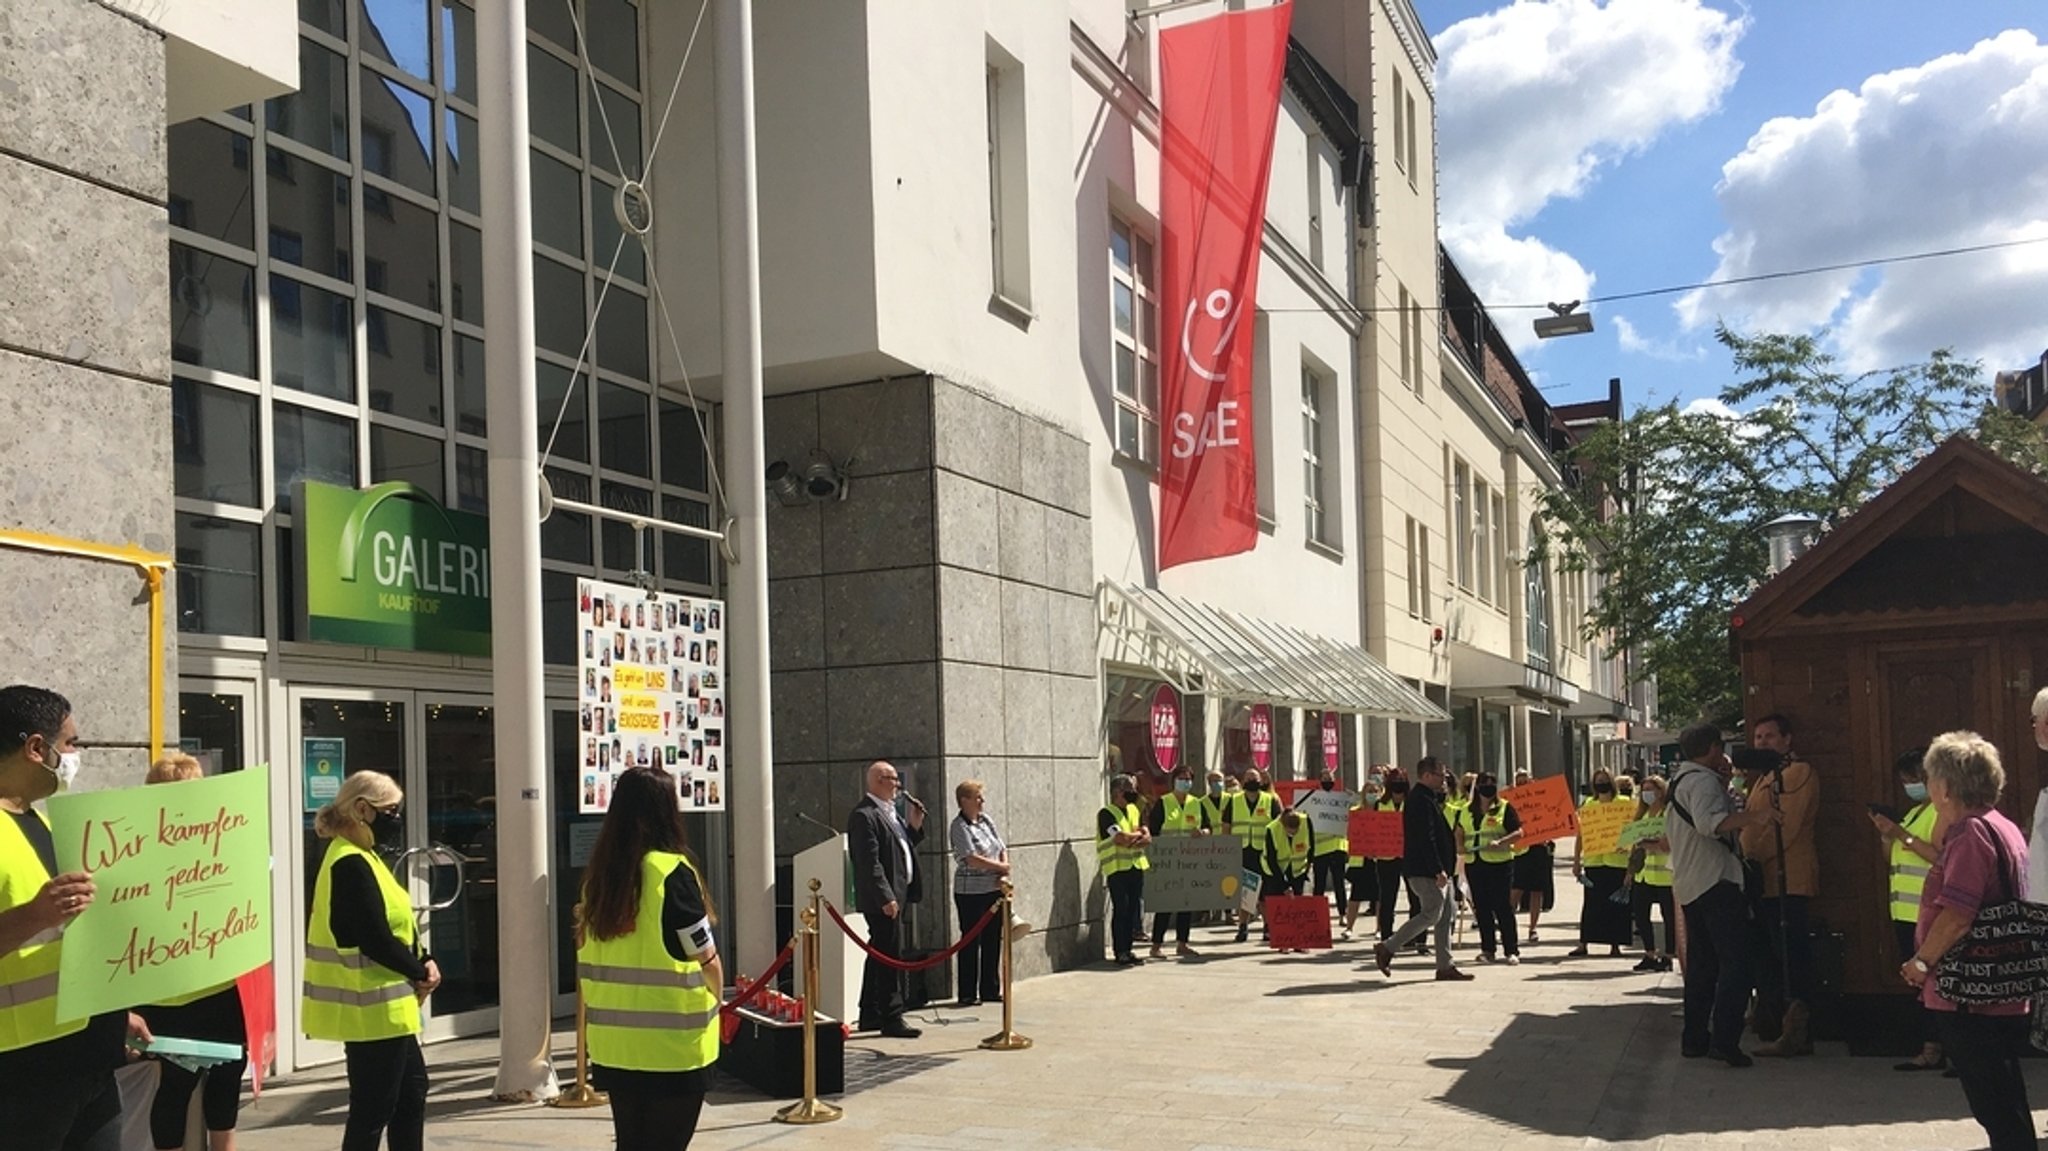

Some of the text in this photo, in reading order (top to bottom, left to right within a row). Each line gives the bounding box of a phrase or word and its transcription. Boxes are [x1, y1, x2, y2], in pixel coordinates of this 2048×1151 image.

[373, 530, 489, 598] GALERI
[645, 671, 665, 687] UNS
[81, 806, 248, 873] Wir kämpfen
[110, 859, 230, 911] um jeden
[106, 899, 259, 983] Arbeitsplatz
